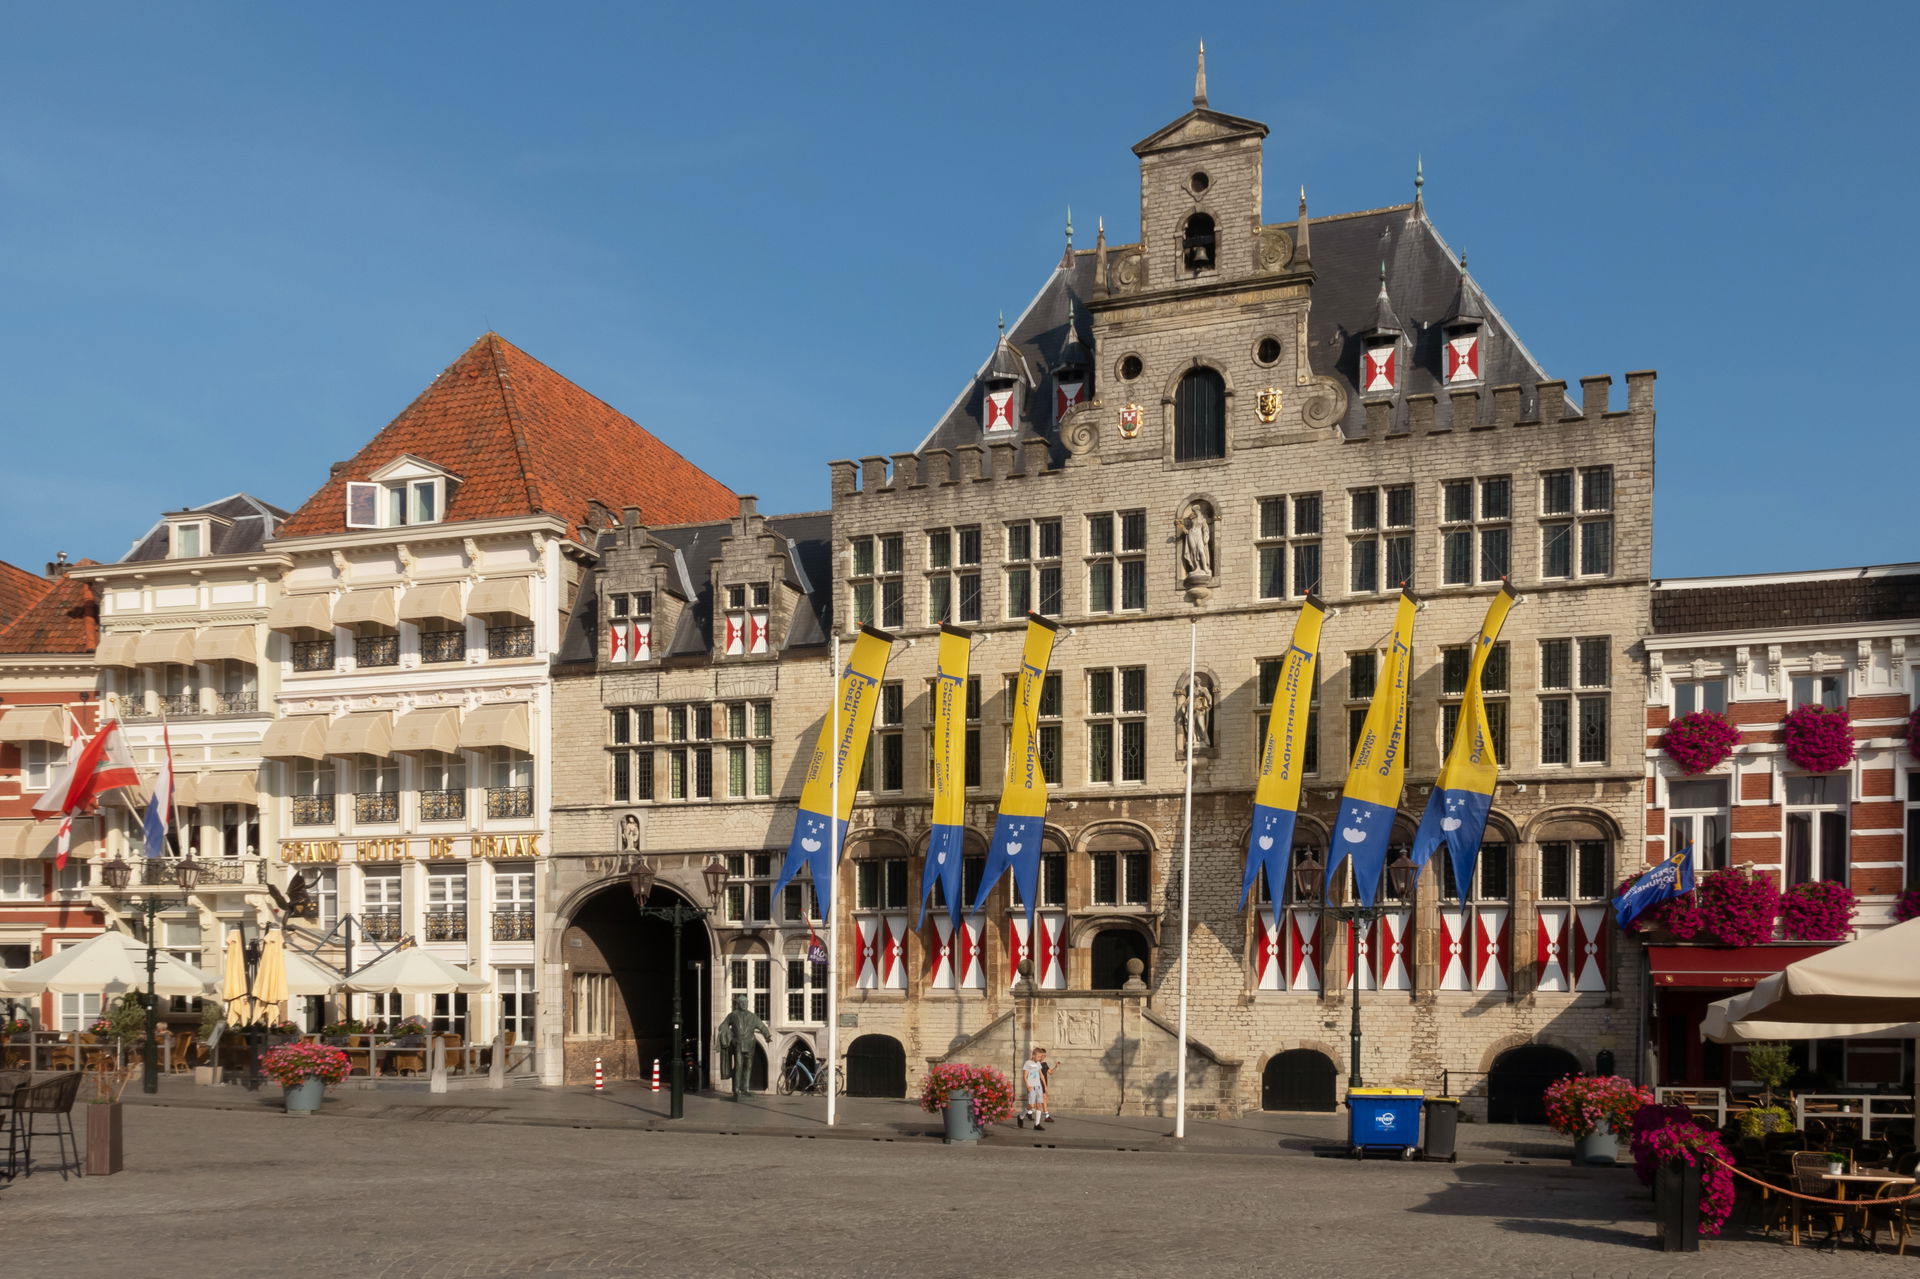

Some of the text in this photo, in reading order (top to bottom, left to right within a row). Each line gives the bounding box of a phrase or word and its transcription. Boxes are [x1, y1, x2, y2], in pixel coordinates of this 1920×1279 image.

[281, 834, 541, 863] GRAND HOTEL DE DRAAK
